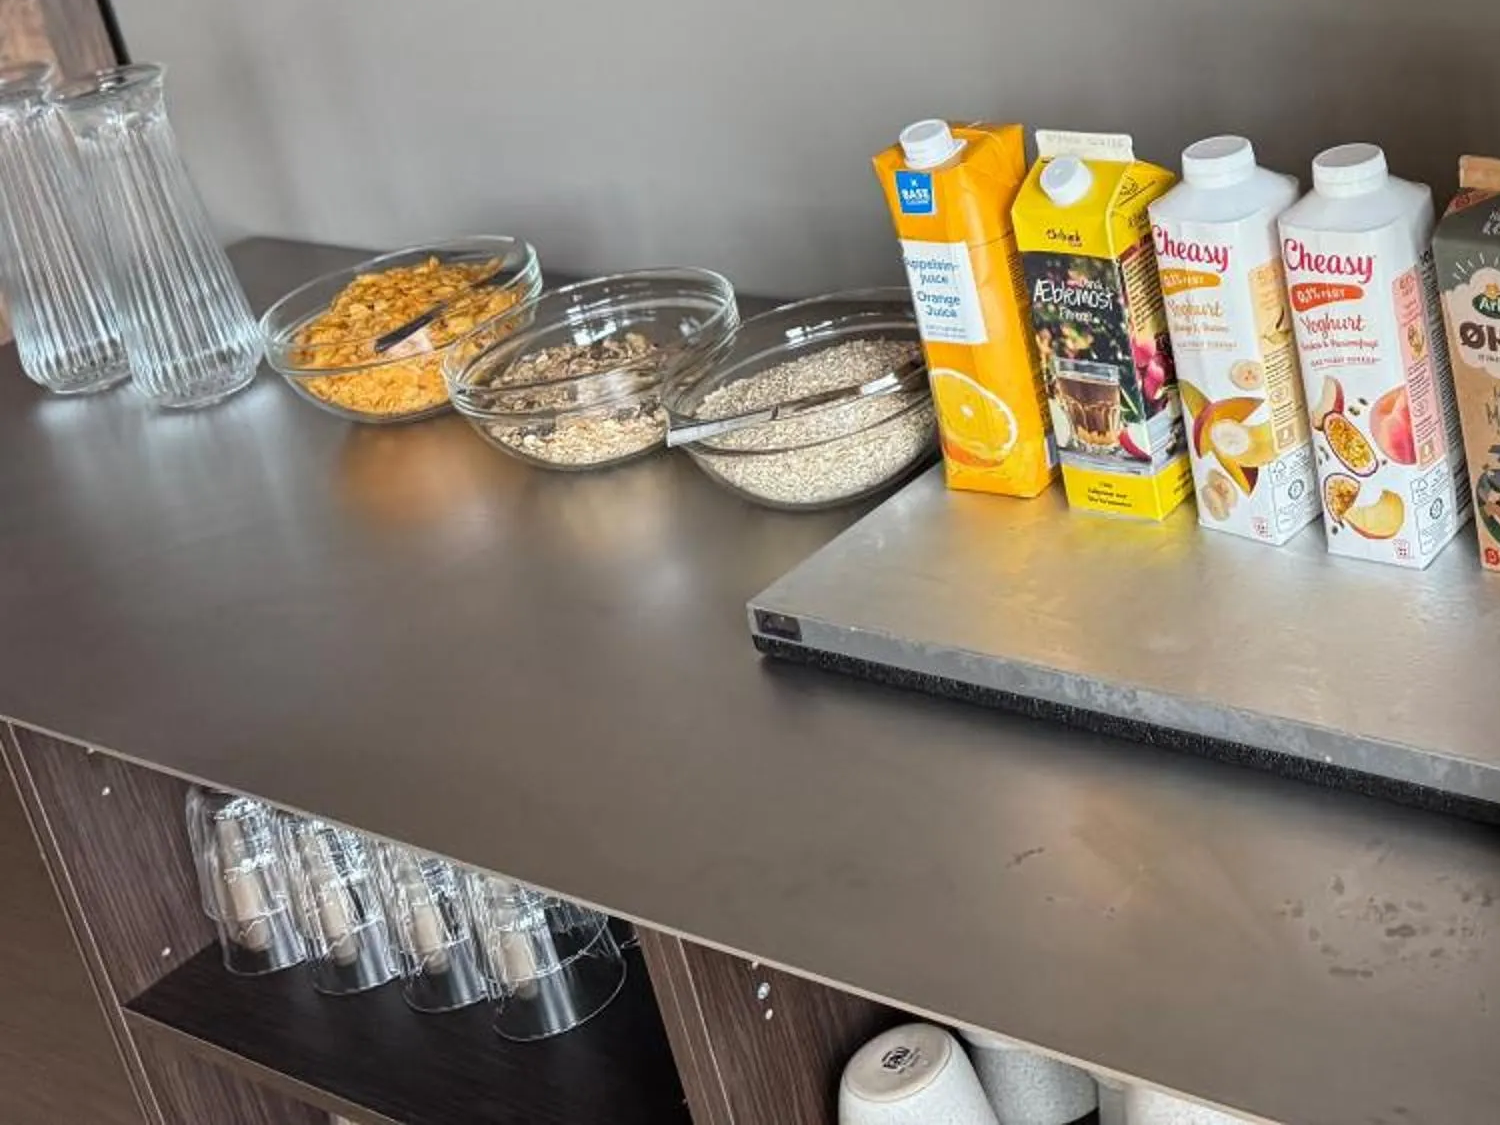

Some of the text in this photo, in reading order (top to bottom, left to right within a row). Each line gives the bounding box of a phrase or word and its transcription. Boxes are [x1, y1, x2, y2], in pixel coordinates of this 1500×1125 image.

[1151, 224, 1230, 274] Cheasy
[1283, 237, 1373, 284] Cheasy
[916, 289, 961, 308] Orange
[1299, 312, 1367, 340] Yoghurt
